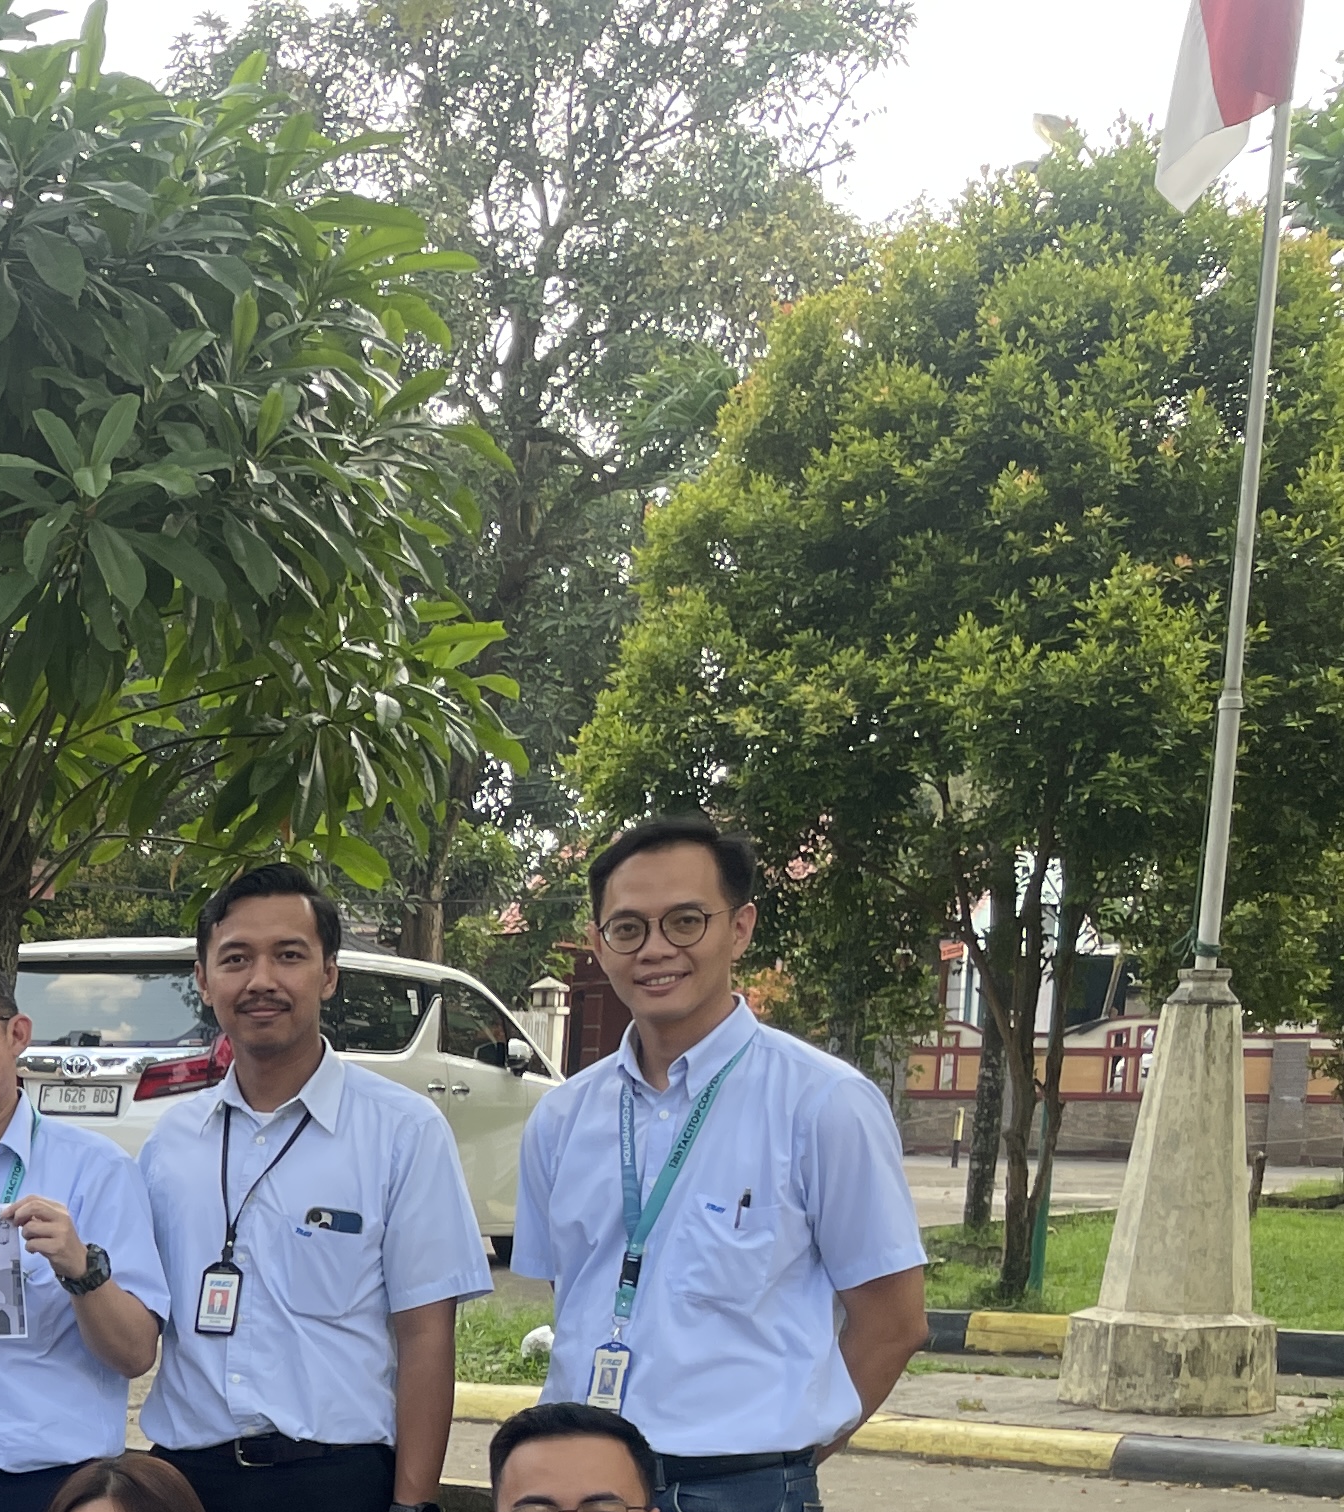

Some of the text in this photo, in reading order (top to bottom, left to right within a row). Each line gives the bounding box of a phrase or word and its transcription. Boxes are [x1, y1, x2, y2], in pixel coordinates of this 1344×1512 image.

[43, 1086, 115, 1104] F 1626 BDS
